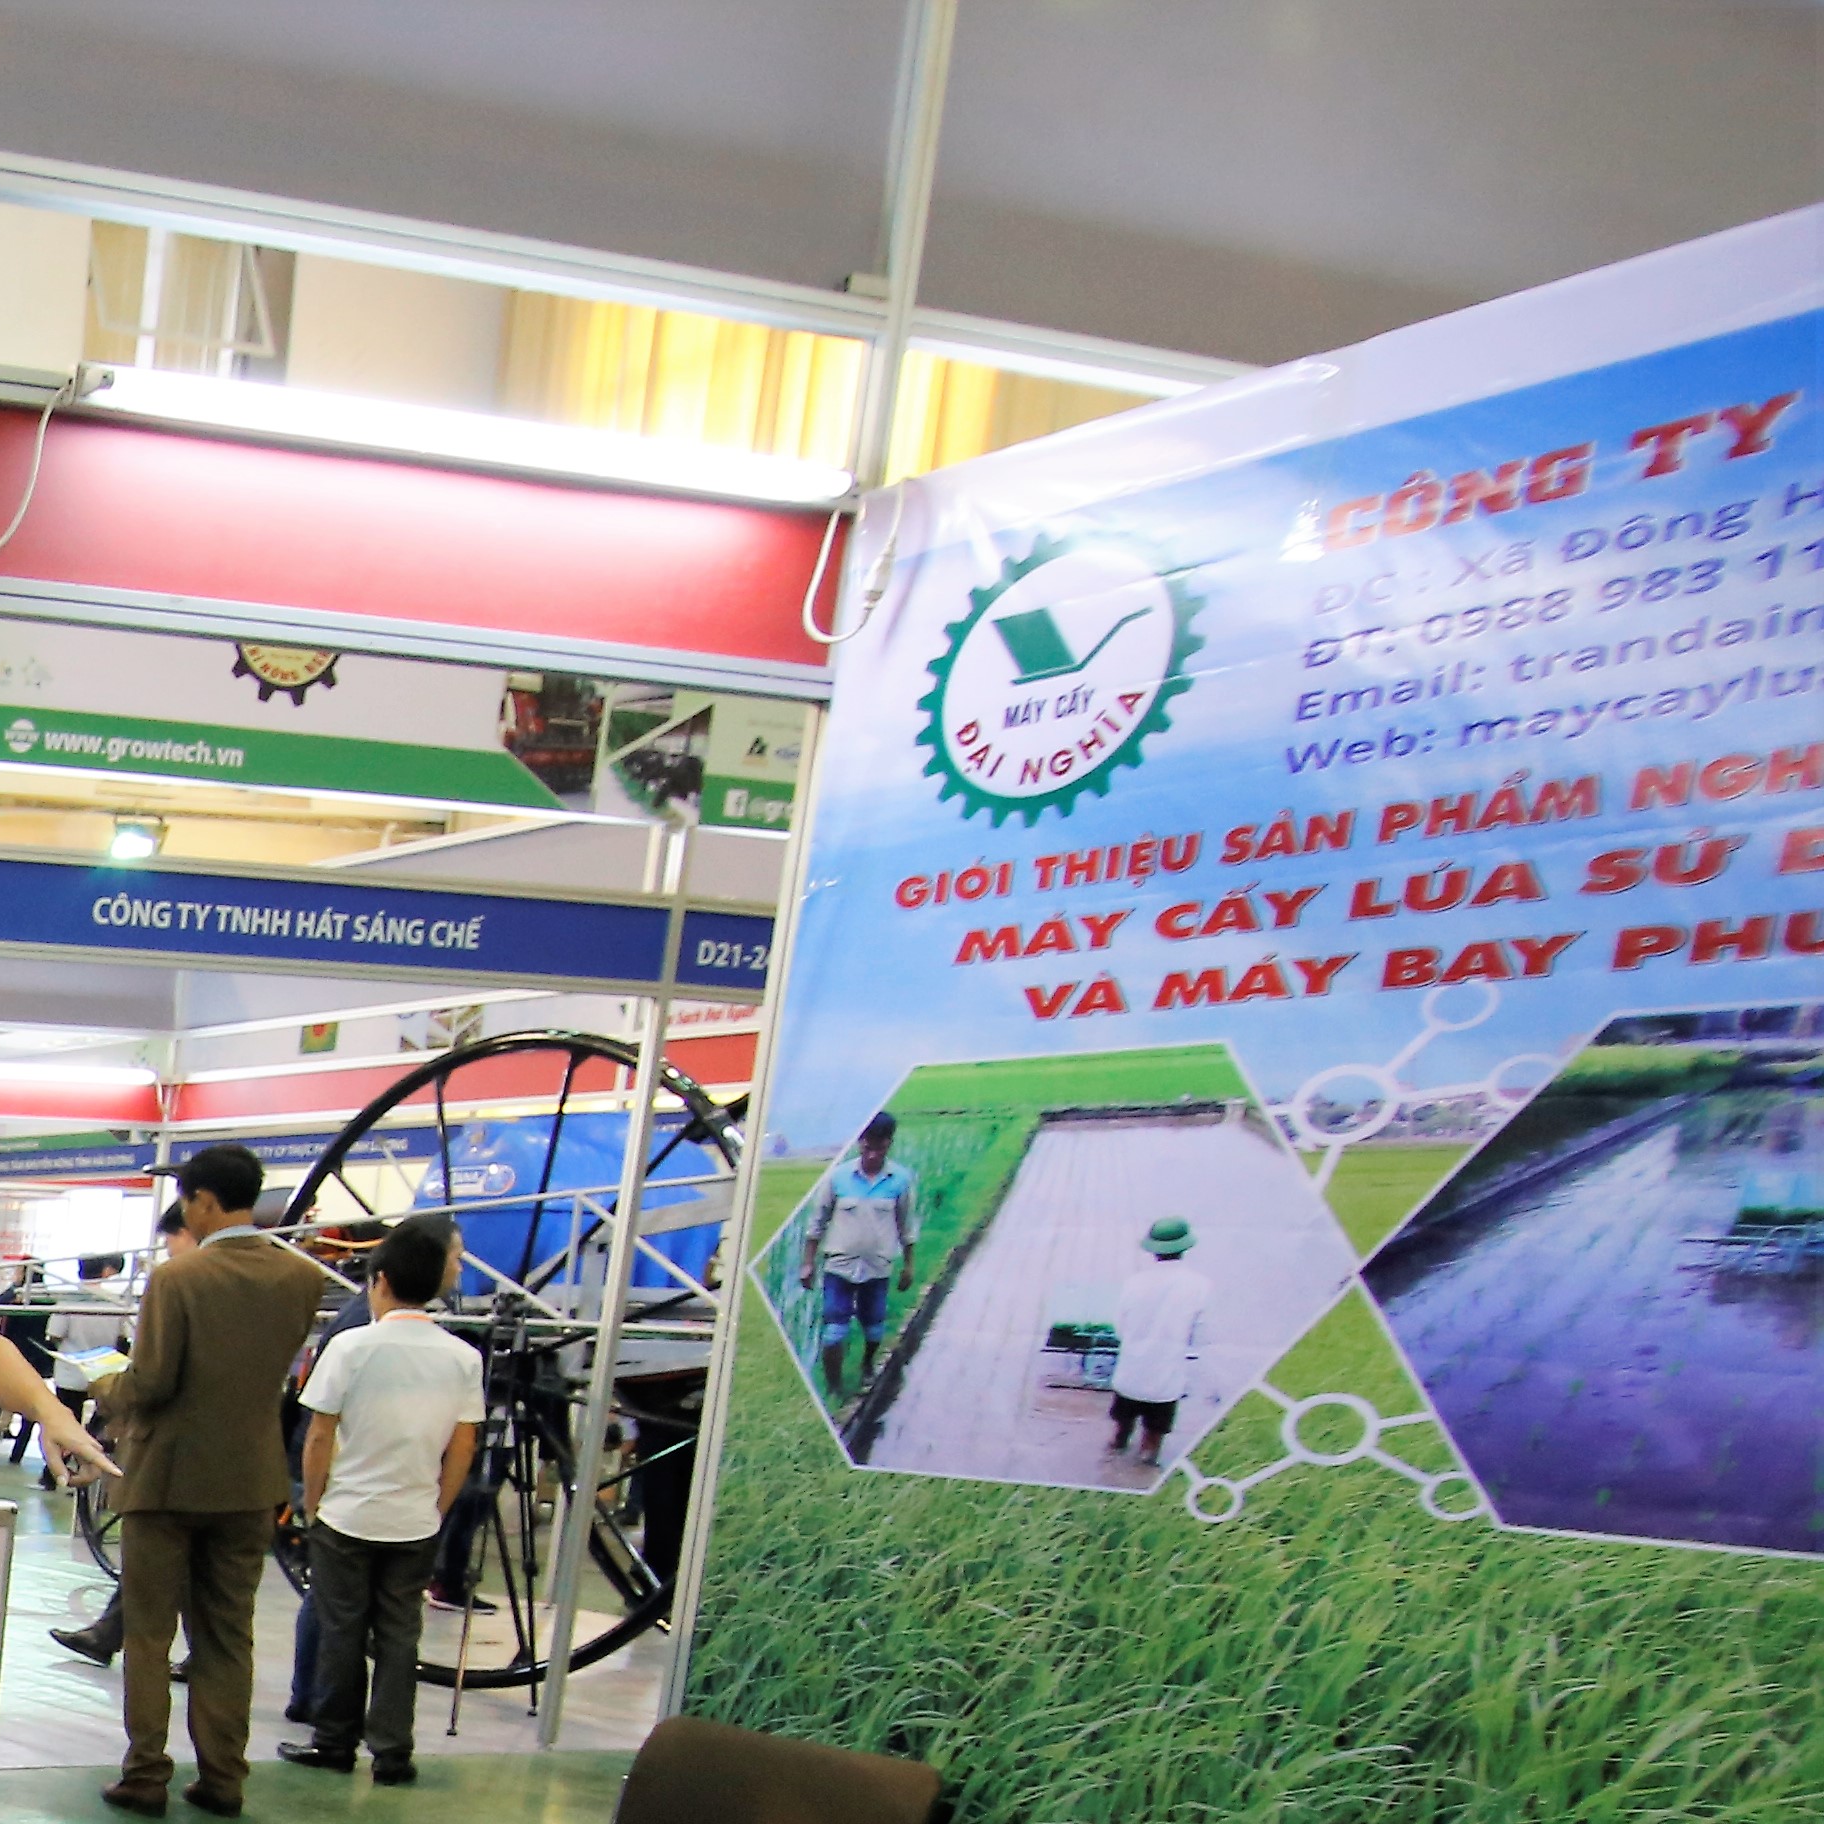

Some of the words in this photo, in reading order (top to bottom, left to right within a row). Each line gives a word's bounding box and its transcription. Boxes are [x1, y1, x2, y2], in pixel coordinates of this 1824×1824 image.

[1324, 441, 1596, 551] CÔNG
[1629, 388, 1802, 478] TY
[1451, 538, 1535, 588] Xã
[1560, 498, 1757, 565] Đông
[1417, 587, 1574, 647] 0988
[1596, 555, 1726, 613] 983
[1003, 697, 1047, 729] MÁY
[1293, 663, 1487, 723] Email:
[45, 731, 245, 768] www.growtech.vn
[1285, 727, 1438, 775] Web:
[894, 855, 1016, 911] GIỚI
[1033, 830, 1206, 893] THIỆU
[1219, 807, 1357, 867] SẢN
[1375, 767, 1602, 846] PHẨM
[92, 892, 172, 929] CÔNG
[178, 900, 212, 933] TY
[216, 903, 291, 936] TNHH
[295, 905, 350, 940] HÁT
[352, 908, 426, 946] SÁNG
[430, 914, 485, 951] CHẾ
[952, 907, 1136, 967] MÁY
[1154, 880, 1330, 942] CẤY
[1346, 856, 1550, 922] LÚA
[1578, 824, 1751, 896] SỬ
[696, 939, 769, 971] D21-2
[1023, 971, 1130, 1023] VÀ
[1152, 952, 1361, 1012] MÁY
[1378, 928, 1588, 992] BAY
